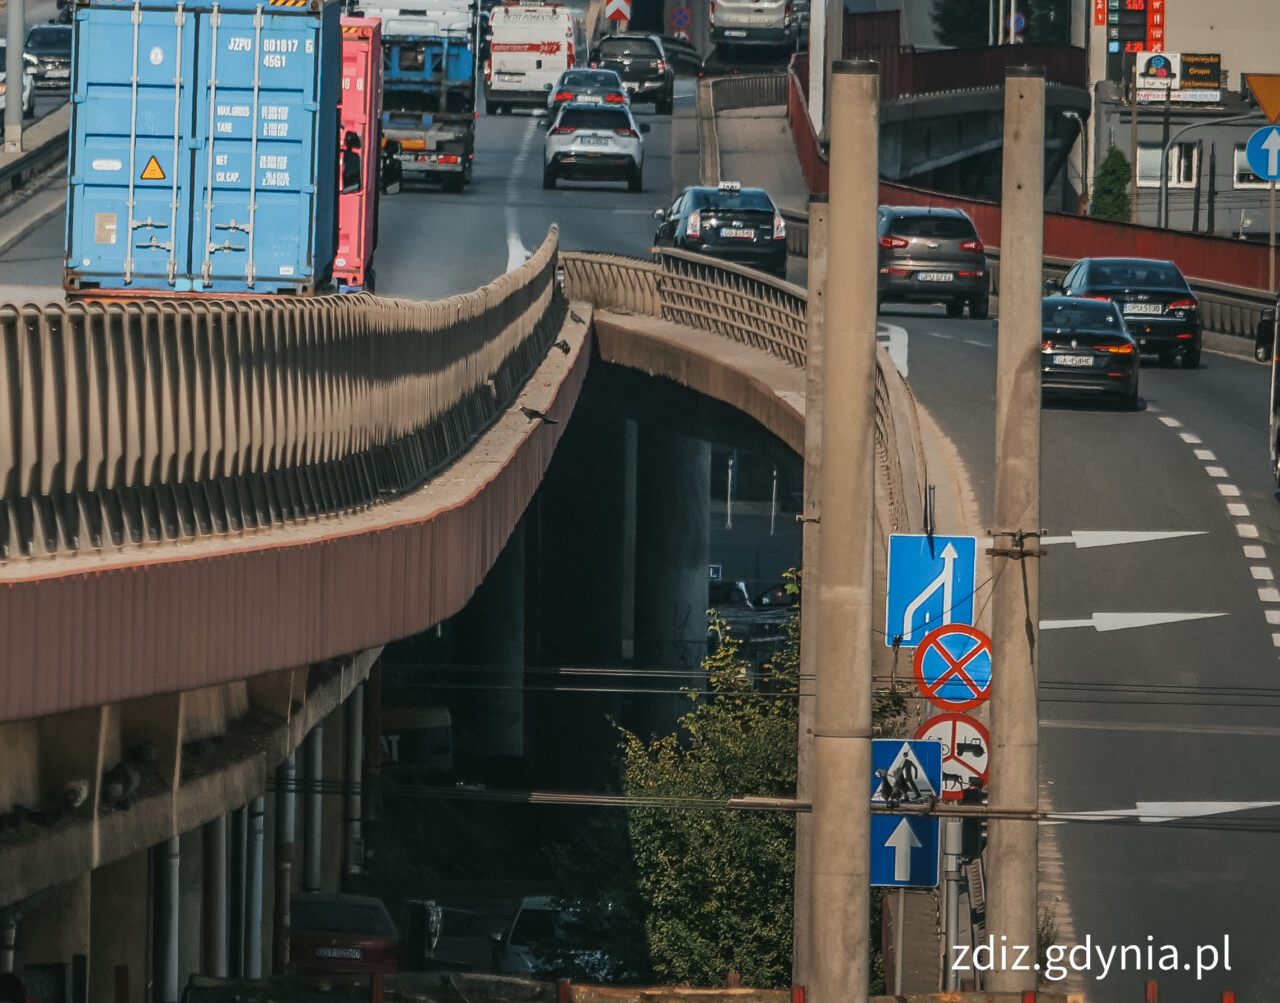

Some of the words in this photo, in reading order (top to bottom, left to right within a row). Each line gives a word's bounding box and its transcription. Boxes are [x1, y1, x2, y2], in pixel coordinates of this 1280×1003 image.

[228, 38, 252, 51] JZPU
[263, 39, 298, 53] 801817
[263, 54, 286, 68] 45G1
